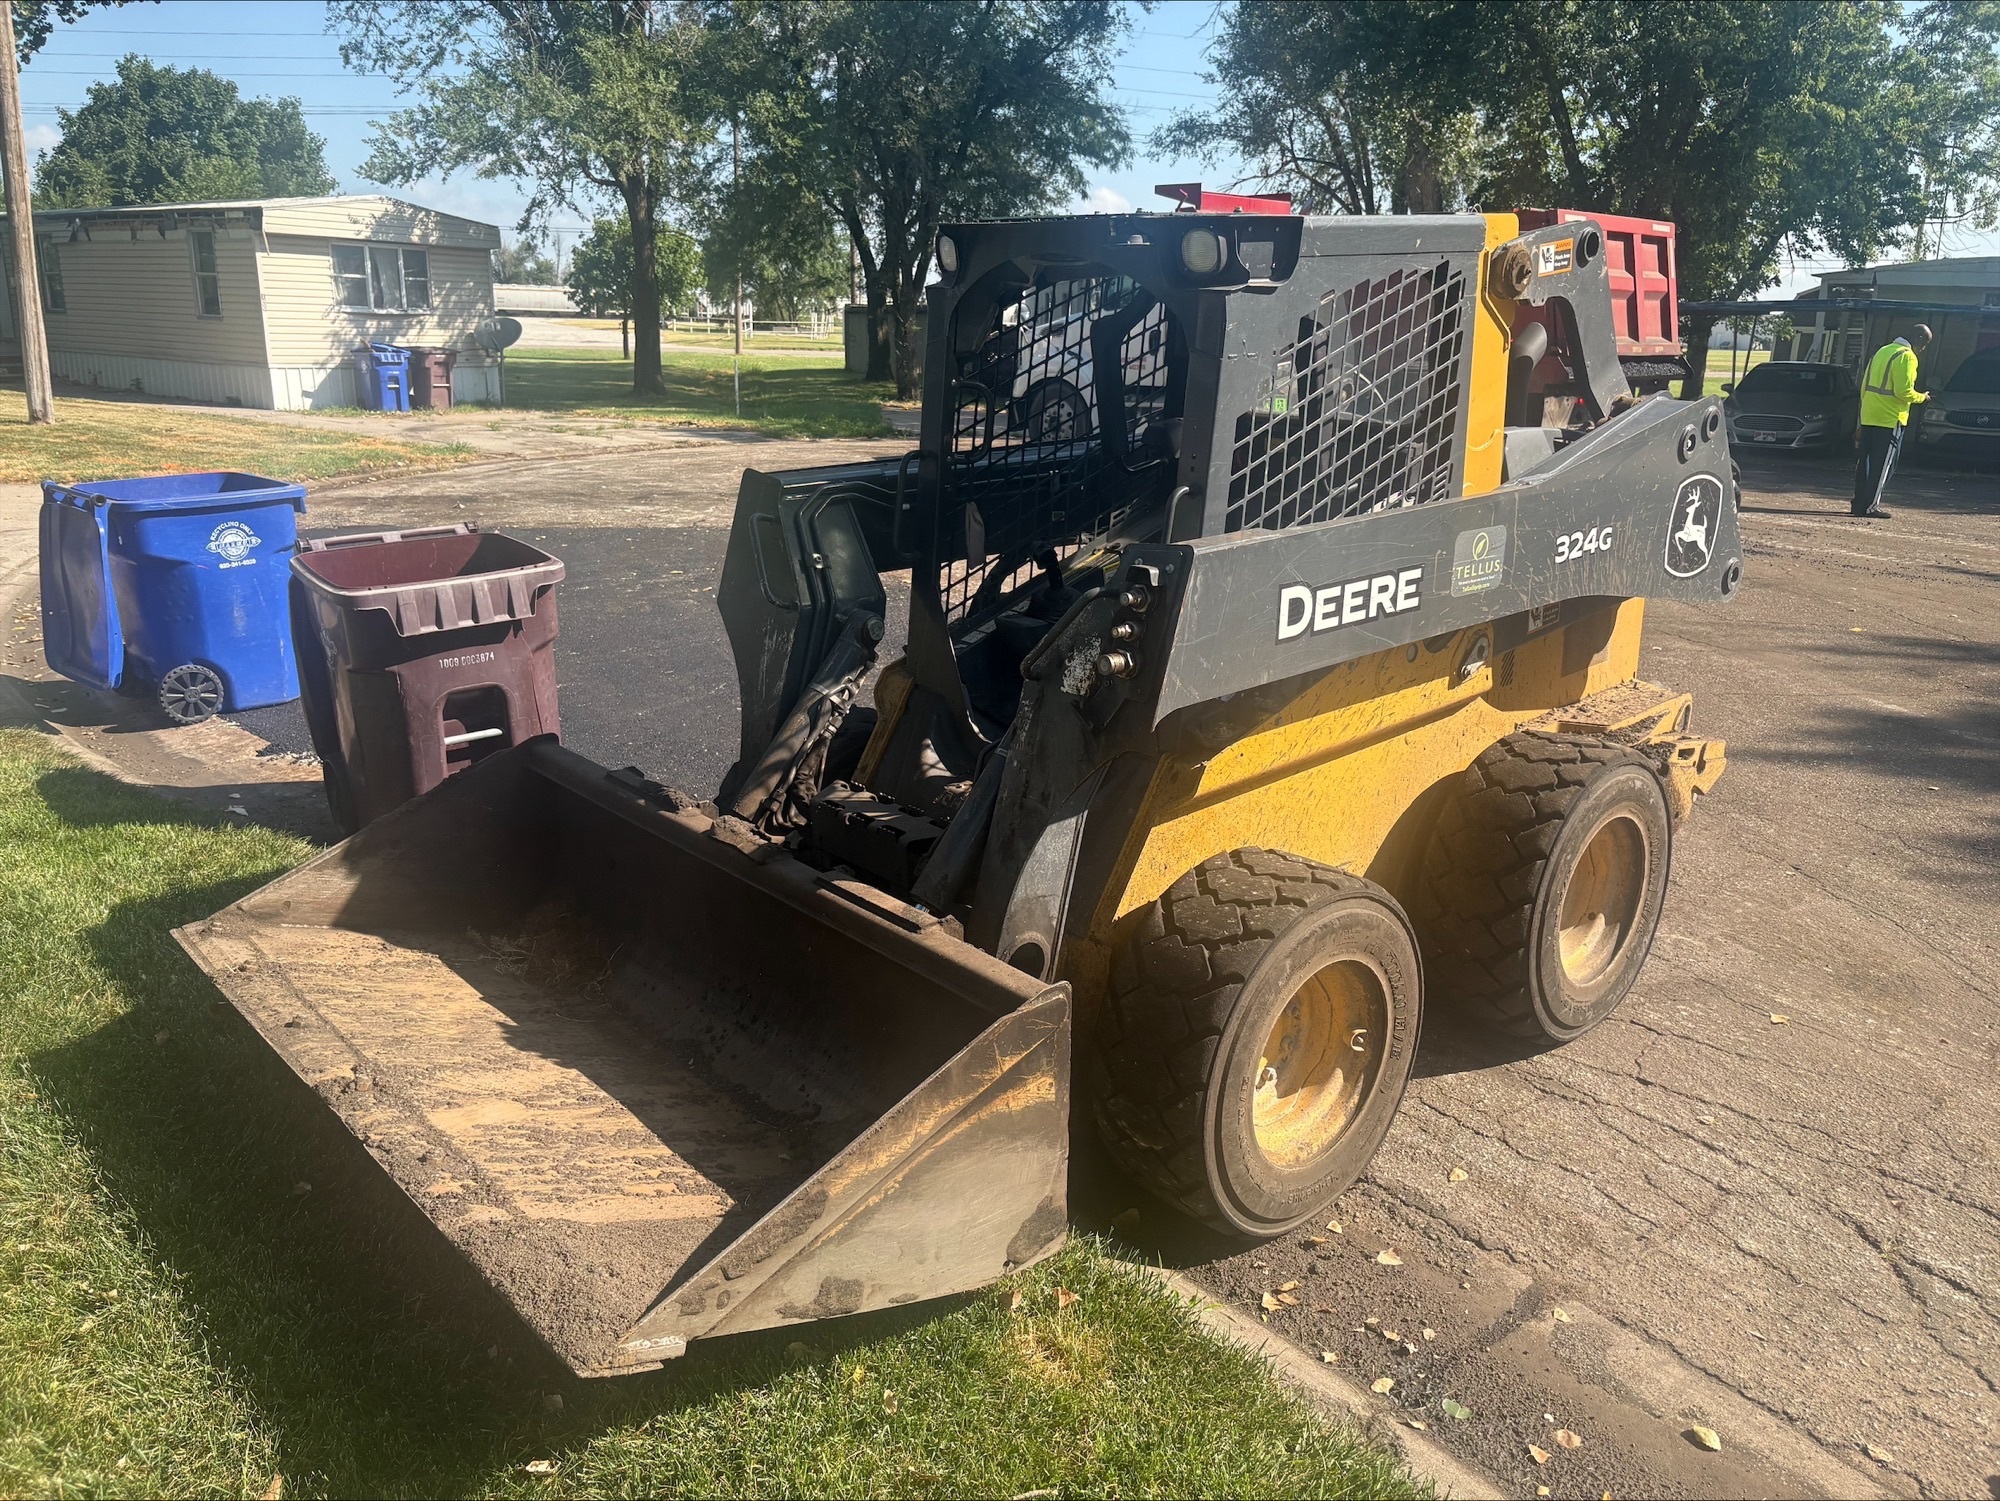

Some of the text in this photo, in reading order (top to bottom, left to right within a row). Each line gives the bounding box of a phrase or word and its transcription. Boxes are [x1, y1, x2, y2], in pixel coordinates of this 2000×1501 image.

[210, 521, 254, 541] RECYCLING ONLY
[1554, 527, 1613, 564] 324G
[1456, 559, 1501, 580] TELLUS
[1277, 567, 1423, 641] DEERE
